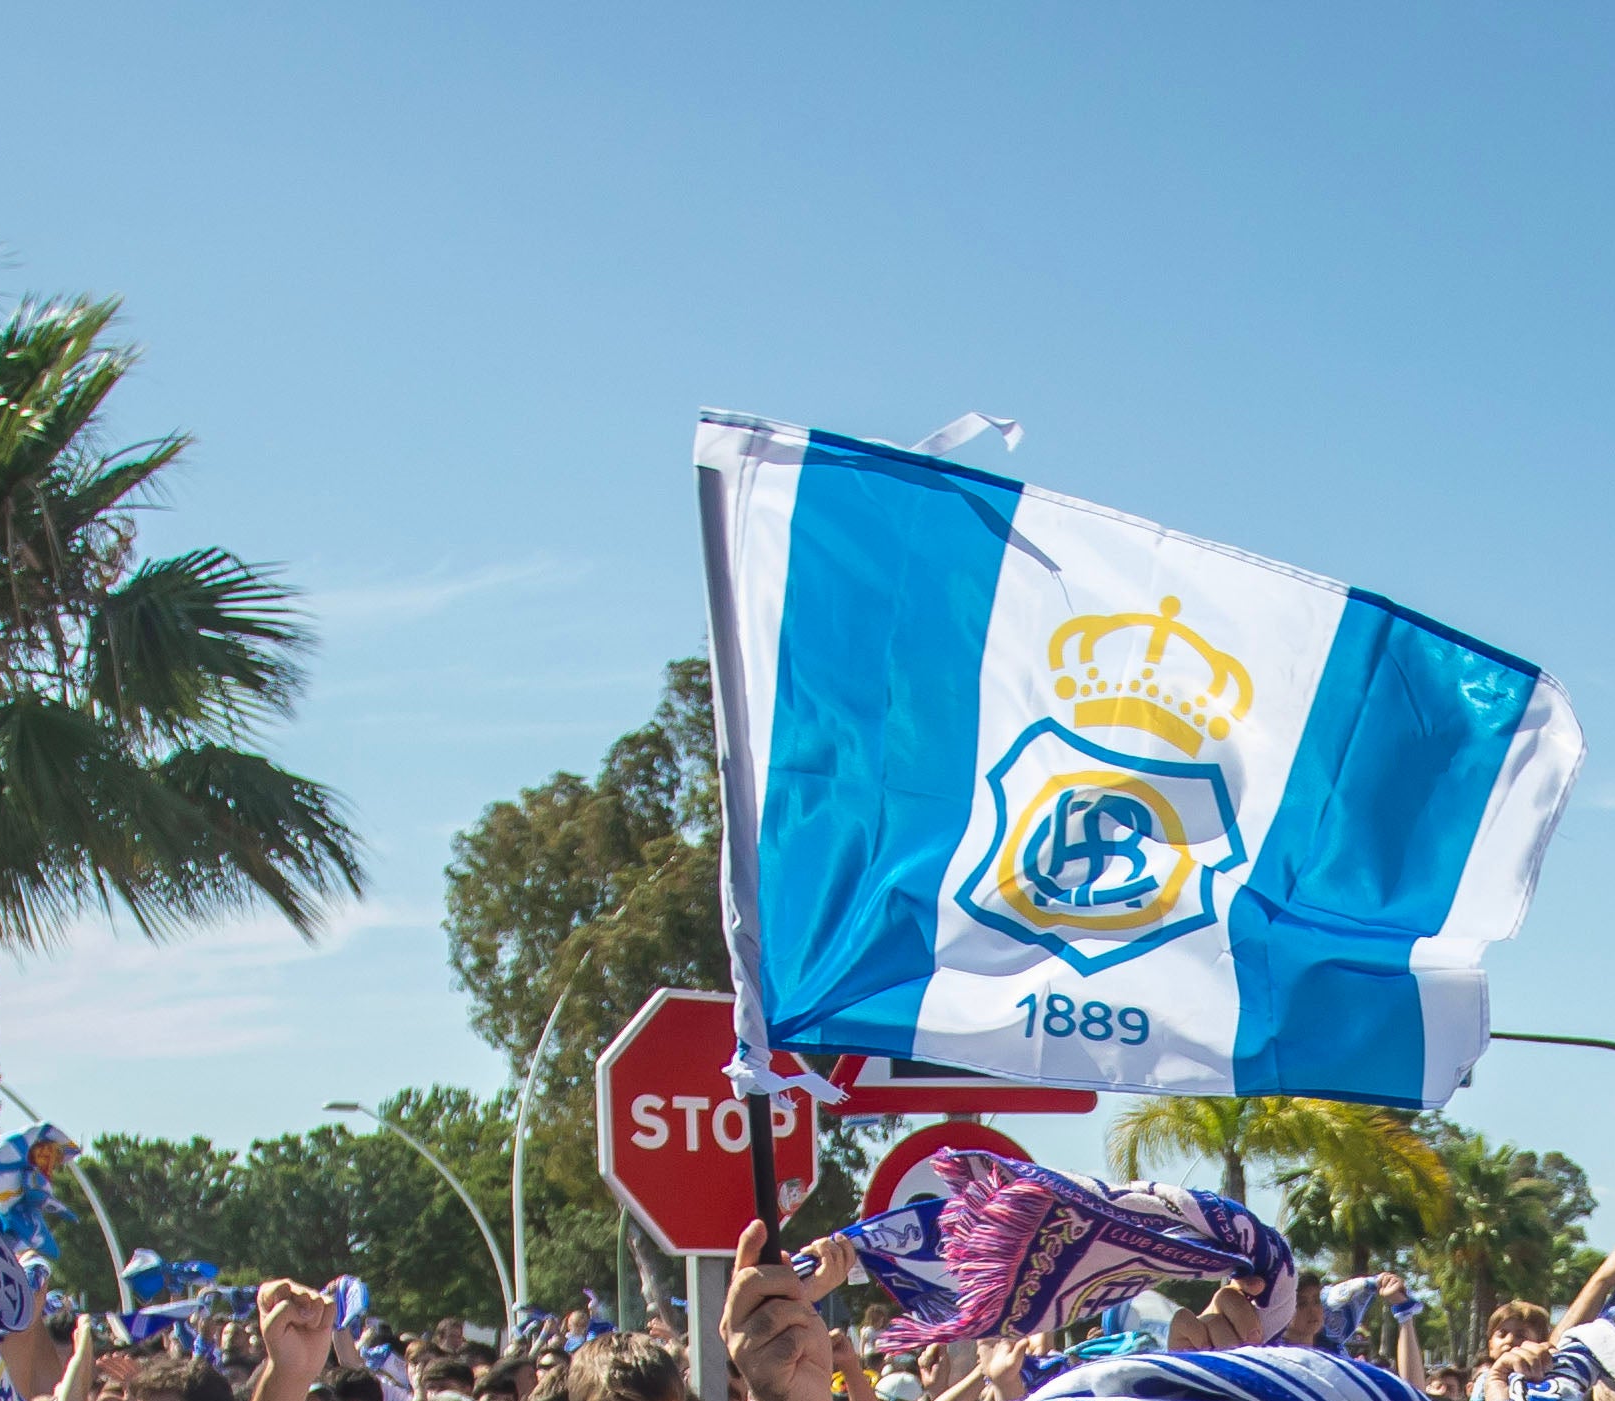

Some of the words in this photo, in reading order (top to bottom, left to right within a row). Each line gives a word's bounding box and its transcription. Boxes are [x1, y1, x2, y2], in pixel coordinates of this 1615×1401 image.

[1016, 992, 1151, 1046] 1889
[630, 1092, 796, 1153] STOP
[1109, 1226, 1153, 1252] CLUB
